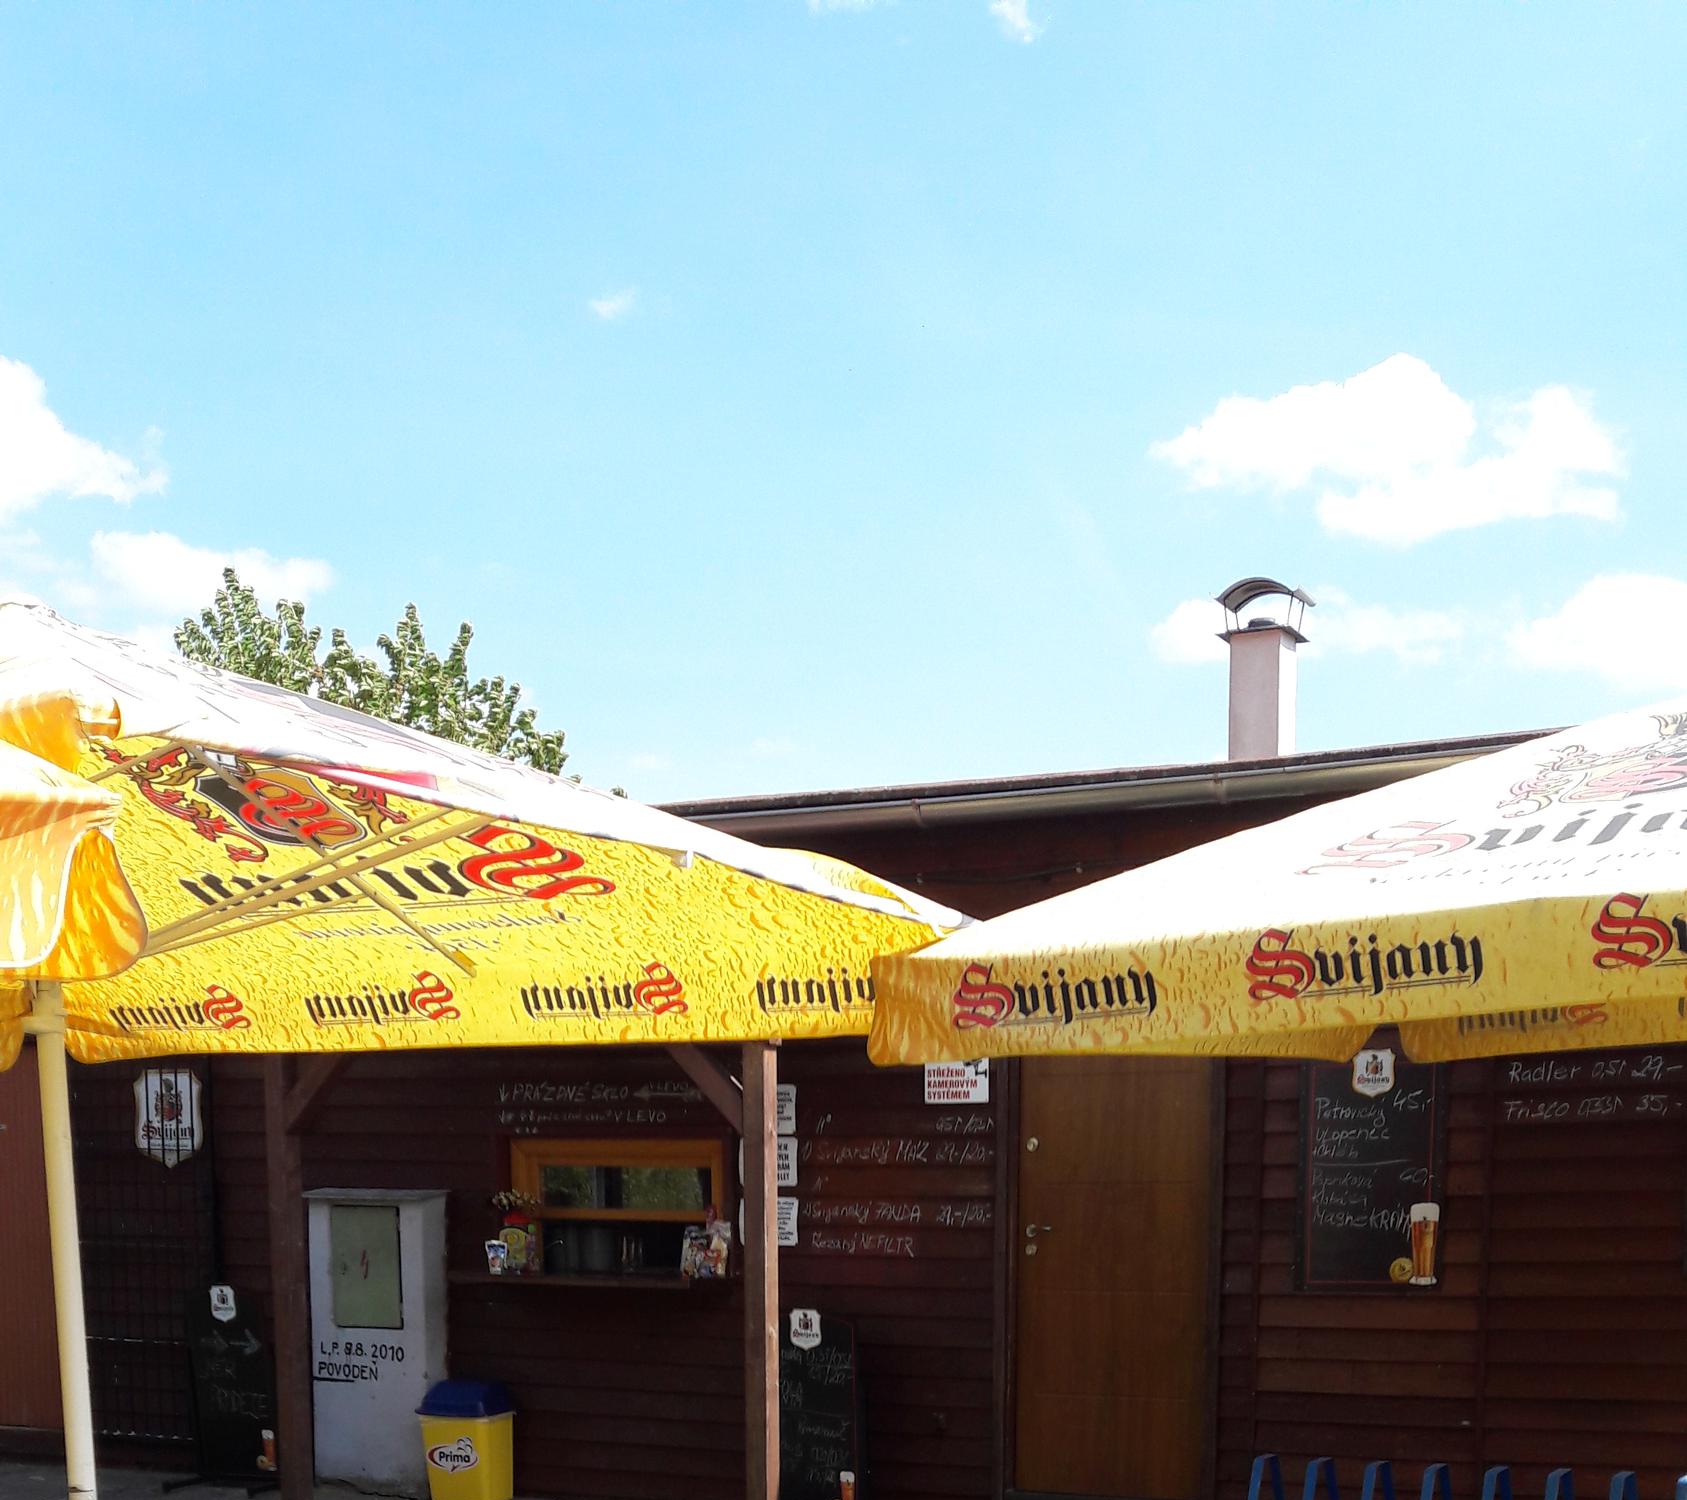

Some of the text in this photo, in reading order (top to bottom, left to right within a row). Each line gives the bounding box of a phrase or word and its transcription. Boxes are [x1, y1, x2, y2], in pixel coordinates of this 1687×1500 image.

[1245, 928, 1482, 1001] Svijany
[953, 962, 1157, 1030] Svijany
[927, 1066, 965, 1078] STŘEŽENO
[1510, 1060, 1582, 1082] Radler
[927, 1077, 977, 1088] KAMEROVÝM
[927, 1088, 970, 1100] SYSTÉMEM
[371, 1344, 405, 1363] 2010
[318, 1361, 378, 1381] POVODEŇ
[439, 1450, 471, 1464] Prima
